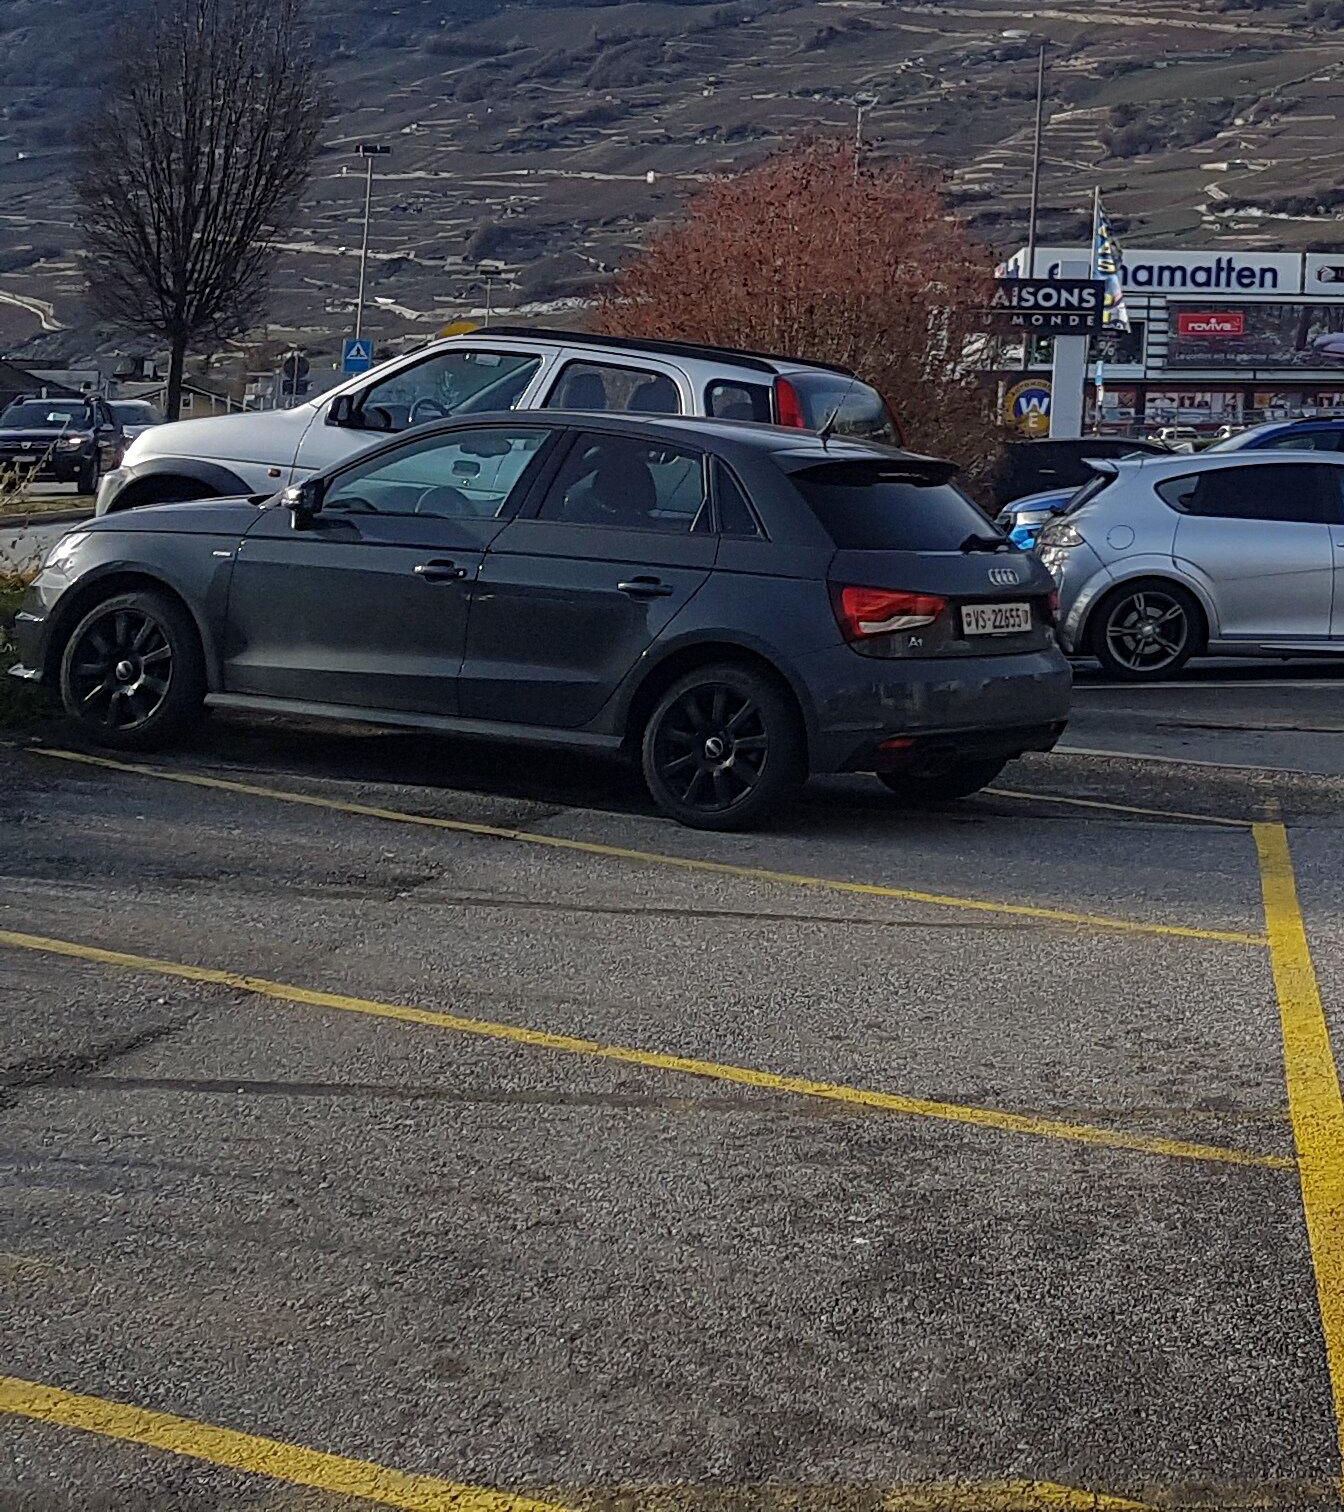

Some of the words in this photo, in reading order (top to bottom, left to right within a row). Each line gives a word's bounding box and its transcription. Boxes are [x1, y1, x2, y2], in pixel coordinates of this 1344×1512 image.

[989, 287, 1096, 308] AISONS
[1011, 315, 1095, 326] MONDE
[1187, 317, 1232, 331] roviva
[1019, 397, 1050, 415] W
[908, 636, 923, 648] A1
